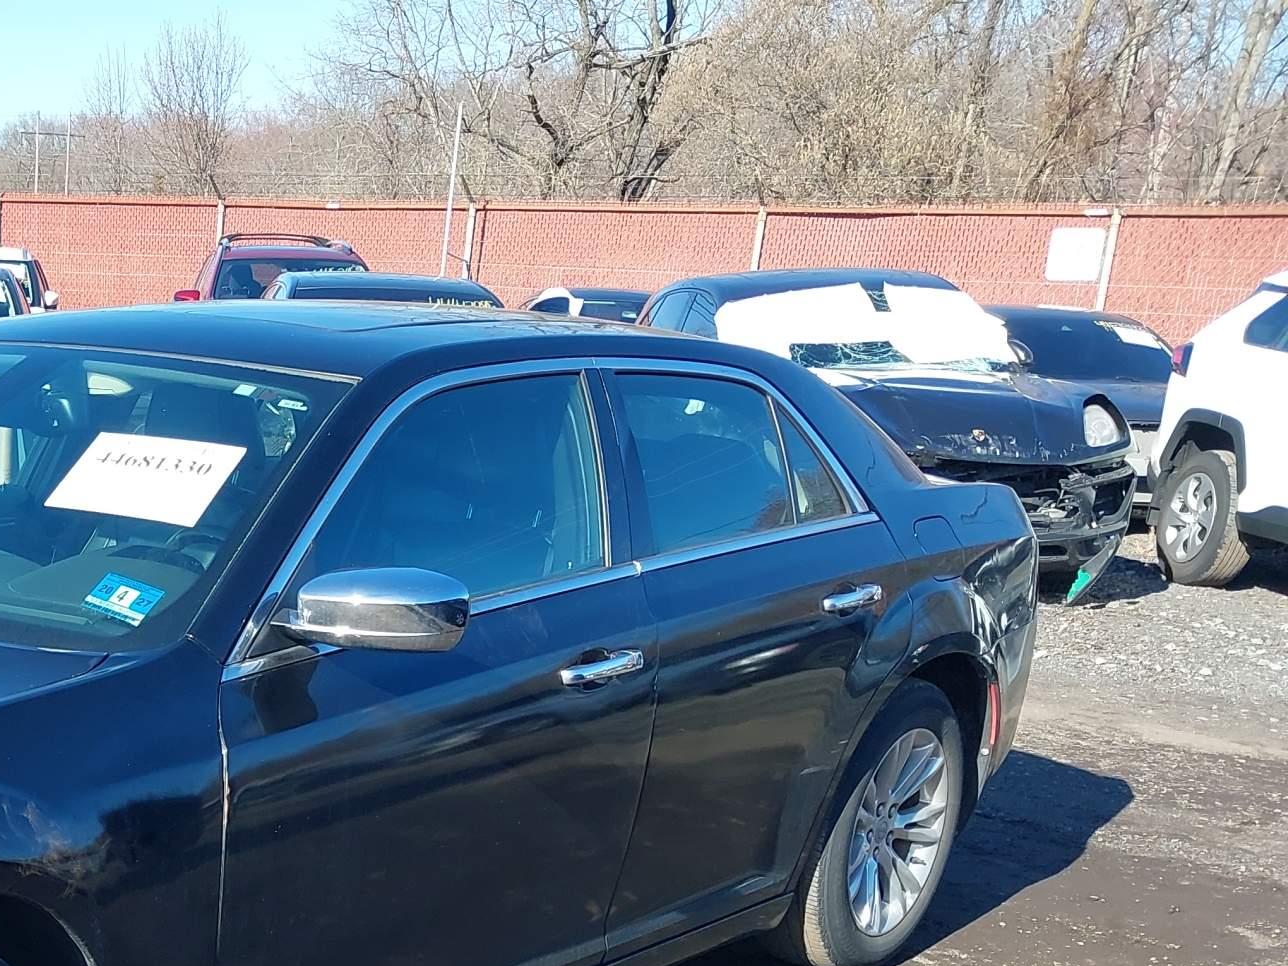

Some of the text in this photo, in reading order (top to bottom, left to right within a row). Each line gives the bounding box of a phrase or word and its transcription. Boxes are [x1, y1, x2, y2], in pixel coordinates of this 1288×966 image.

[96, 452, 212, 475] 44681330
[98, 584, 153, 608] 20 4 27
